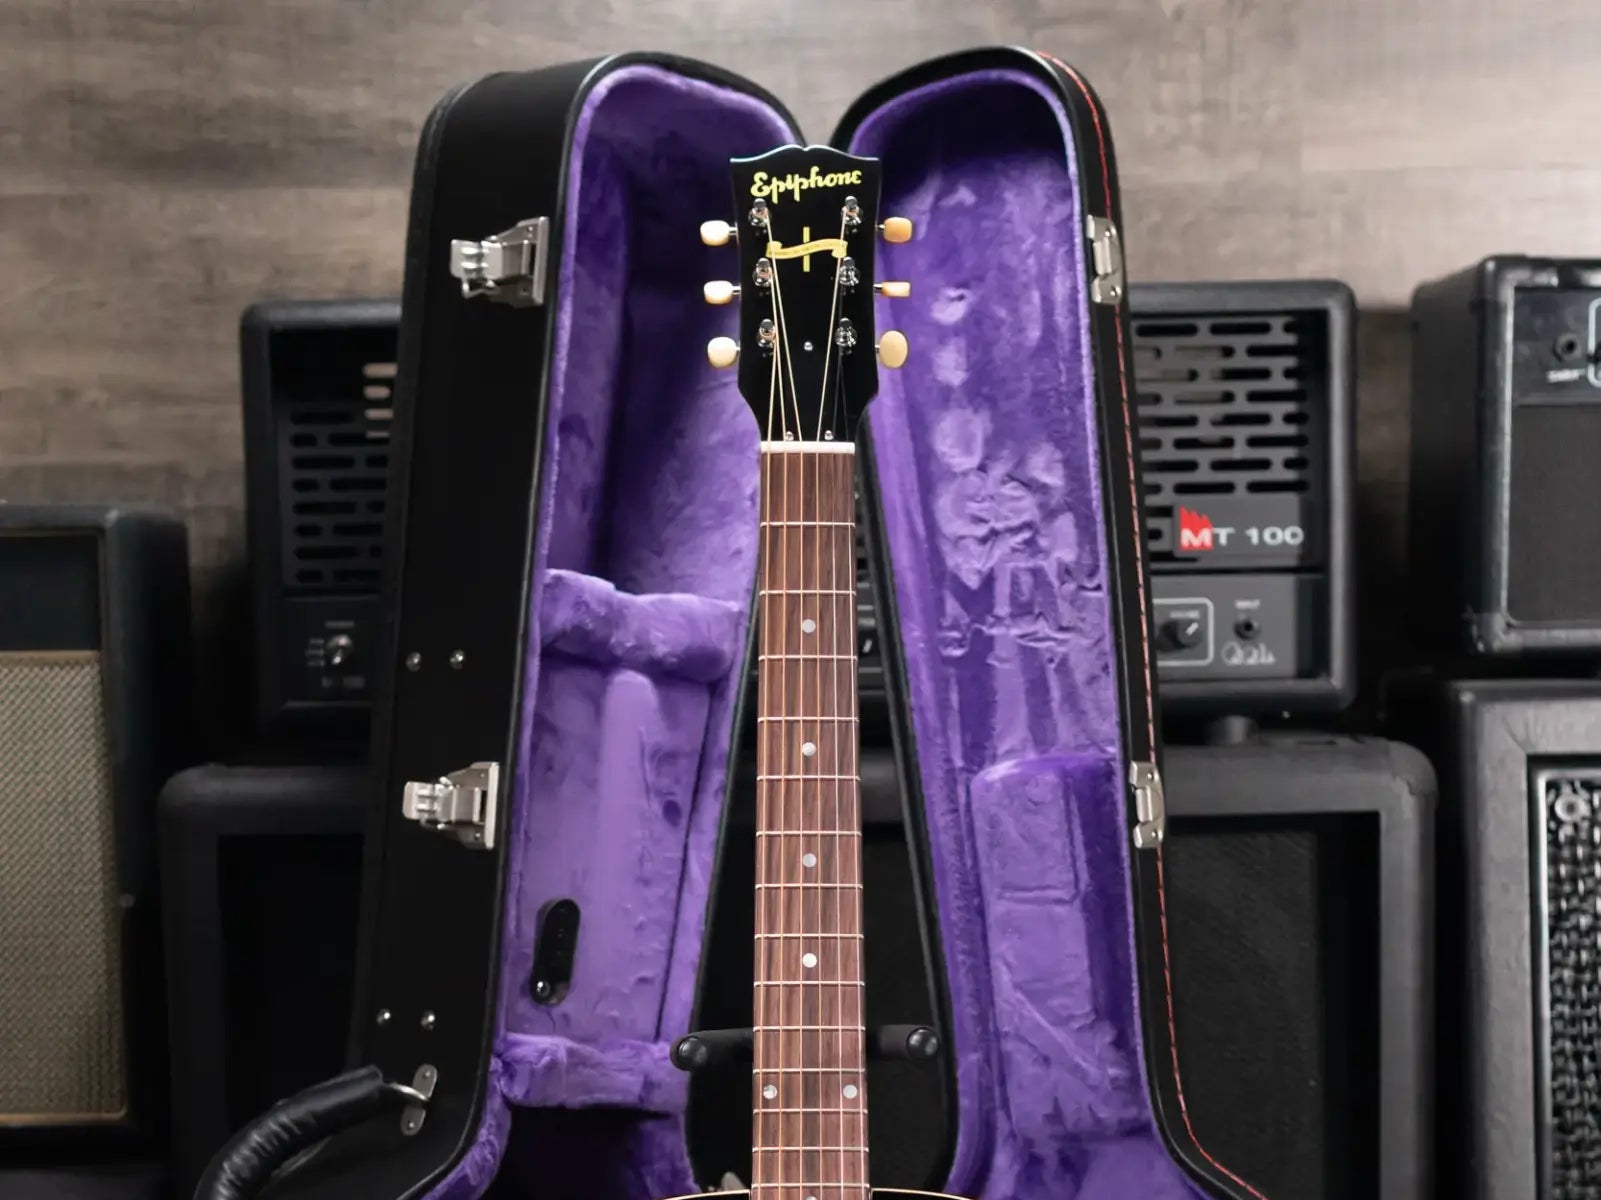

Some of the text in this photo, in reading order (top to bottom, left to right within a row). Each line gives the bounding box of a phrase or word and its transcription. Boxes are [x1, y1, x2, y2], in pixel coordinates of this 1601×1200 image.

[750, 166, 862, 204] Epiphone
[1179, 525, 1304, 548] MT 100
